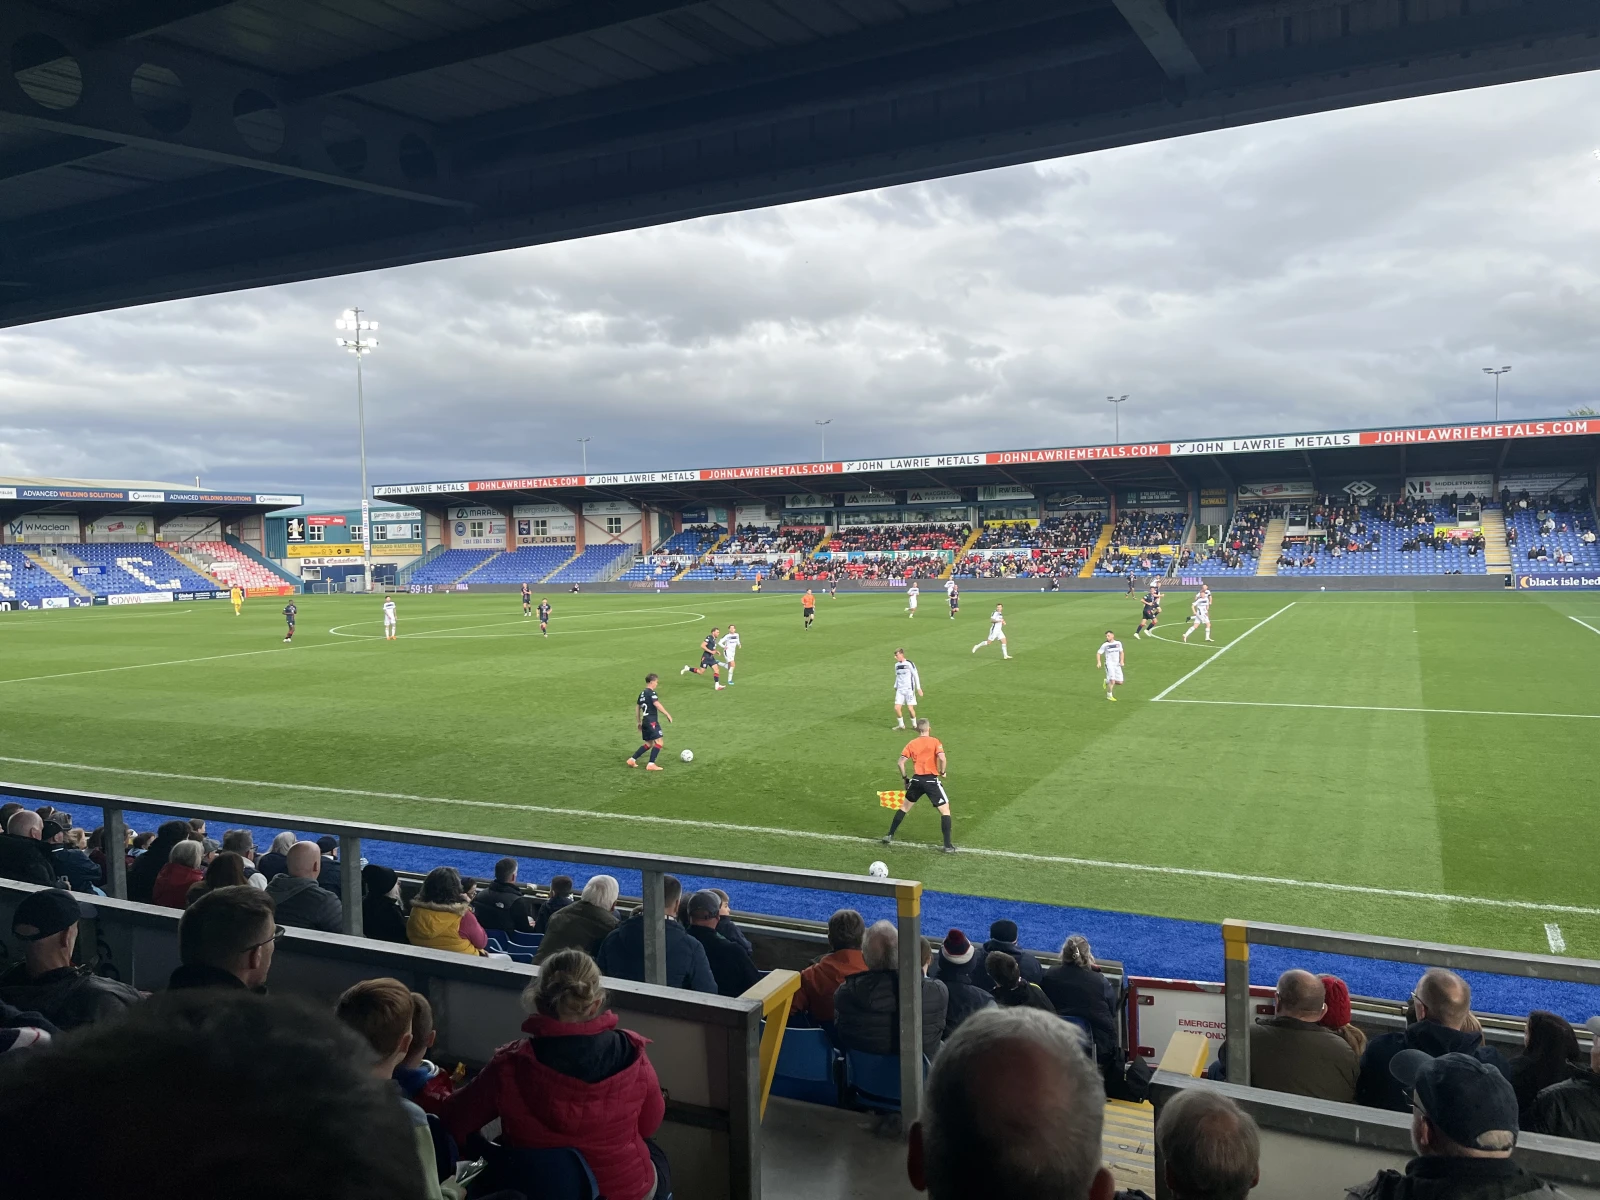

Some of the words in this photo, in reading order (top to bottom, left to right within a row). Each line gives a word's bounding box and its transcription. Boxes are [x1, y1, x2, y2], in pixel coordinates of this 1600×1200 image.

[1374, 421, 1588, 444] JOHNLAWRIEMETALS.COM
[1190, 442, 1224, 453] JOHN
[1233, 438, 1286, 451] LAWRIE
[1295, 434, 1351, 448] METALS
[997, 445, 1159, 463] JOHNLAWRIEMETALS.COM
[857, 461, 883, 470] JOHN
[890, 458, 930, 468] LAWRIE
[937, 456, 980, 466] METALS
[709, 464, 834, 478] JOHNLAWRIEMETALS.COM
[476, 478, 578, 490] JOHNLAWRIEMETALS.COM
[597, 475, 618, 484] JOHN
[623, 474, 656, 482] LAWRIE
[661, 472, 695, 481] METALS
[384, 486, 402, 494] JOHN
[406, 485, 432, 494] LAWRIE
[436, 484, 465, 492] METALS
[34, 523, 70, 531] Maclean
[522, 536, 538, 544] G.F.
[540, 536, 558, 544] JOB
[1529, 578, 1558, 587] black
[1561, 577, 1580, 586] isle
[410, 584, 433, 593] 59:15
[0, 602, 12, 612] n
[1178, 1018, 1227, 1030] EMERGENC
[1205, 1031, 1227, 1040] ONLY
